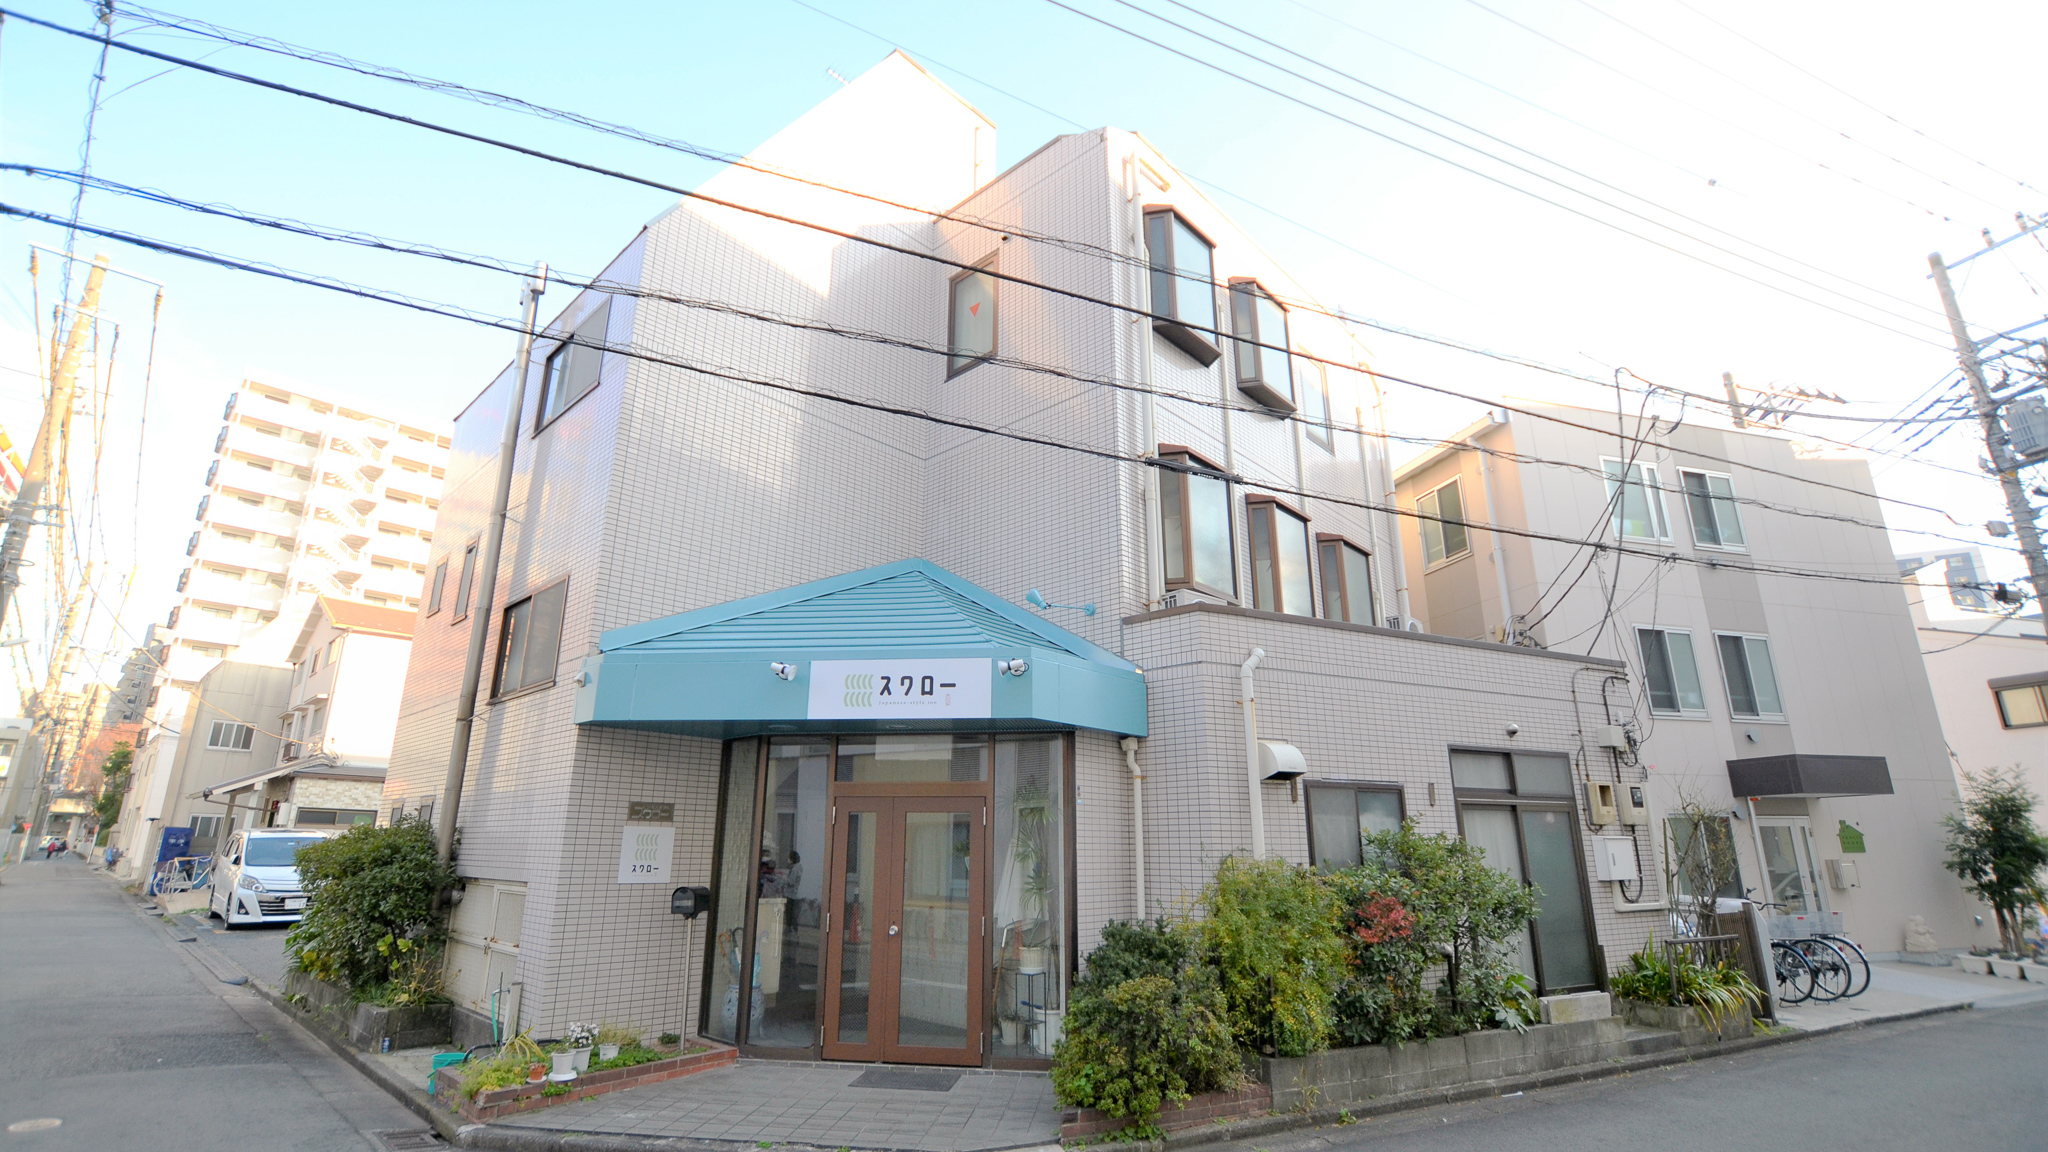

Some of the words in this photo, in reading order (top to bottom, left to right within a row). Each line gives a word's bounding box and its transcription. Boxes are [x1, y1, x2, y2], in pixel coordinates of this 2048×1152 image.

[879, 675, 957, 697] スワロー
[631, 864, 659, 873] スワロー
